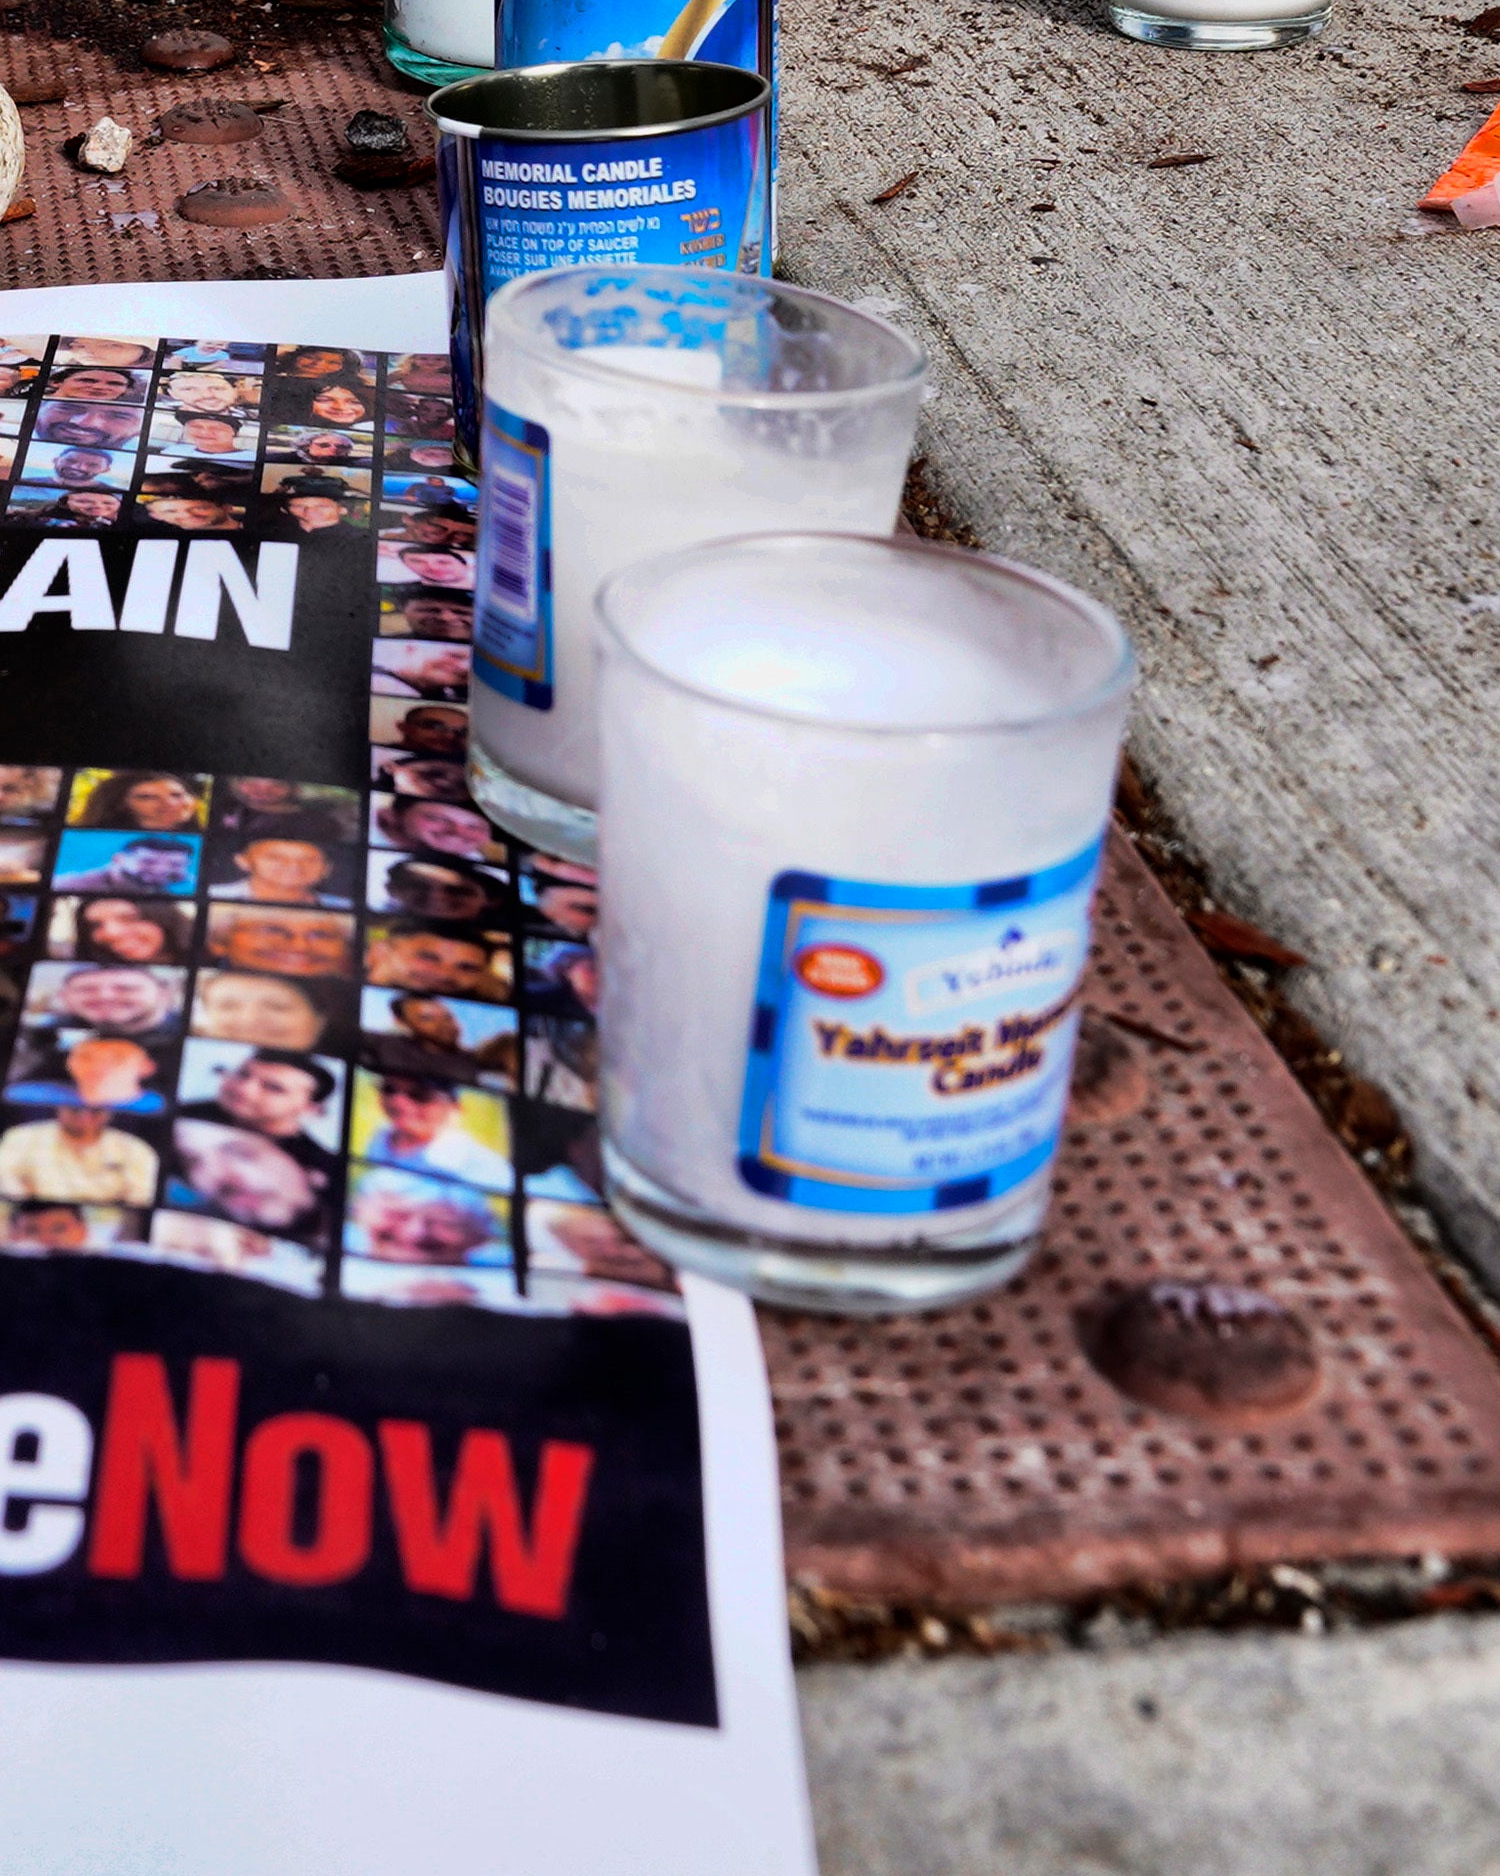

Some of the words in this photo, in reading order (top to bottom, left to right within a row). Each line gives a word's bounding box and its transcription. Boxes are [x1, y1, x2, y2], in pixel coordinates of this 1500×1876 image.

[481, 158, 578, 185] MEMORIAL
[581, 156, 664, 184] CANDLE
[483, 185, 563, 211] BOUGIES
[567, 178, 698, 211] MEMORIALES
[679, 207, 721, 234] כשר
[486, 233, 520, 250] PLACE
[521, 236, 538, 251] ON
[541, 237, 566, 252] TOP
[567, 238, 585, 252] OF
[587, 235, 640, 253] SAUCER
[487, 249, 521, 265] POSER
[523, 252, 548, 267] SUR
[549, 253, 576, 267] UNE
[814, 1019, 985, 1061] Yahrzeit
[931, 1049, 1043, 1097] Candle
